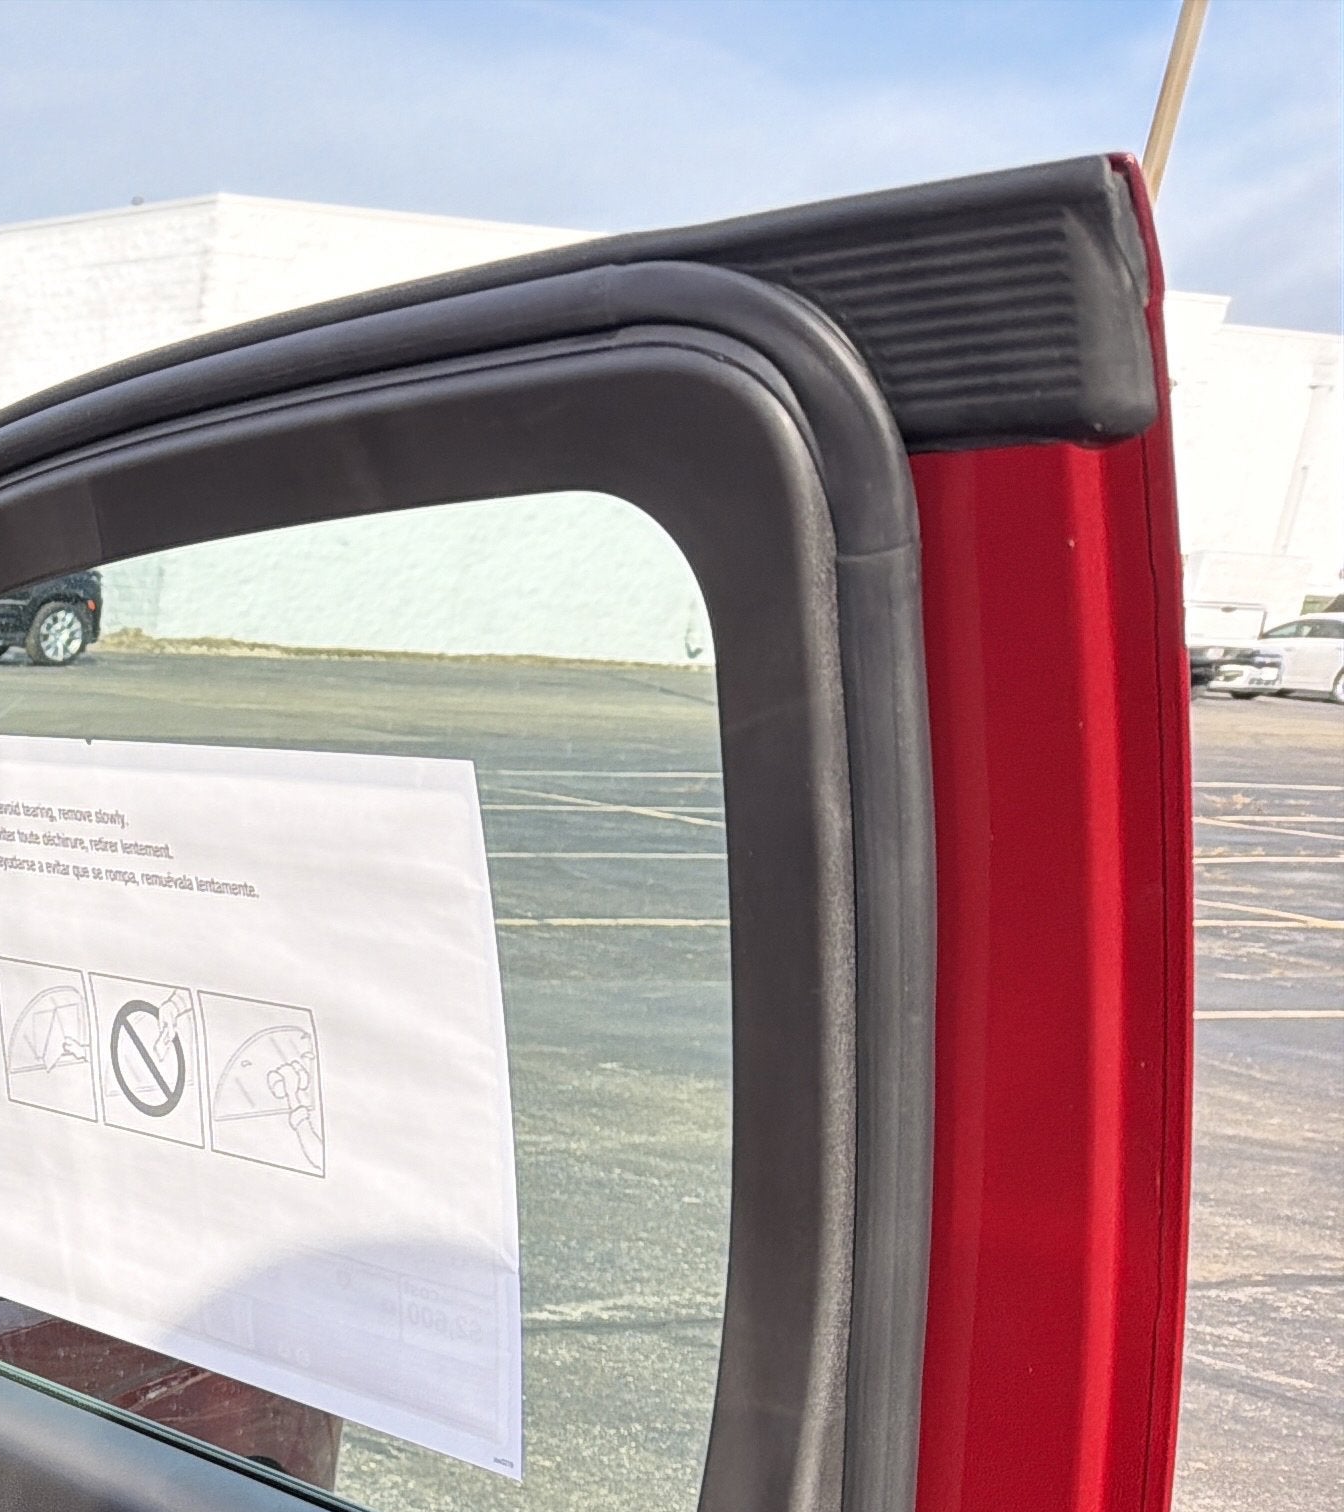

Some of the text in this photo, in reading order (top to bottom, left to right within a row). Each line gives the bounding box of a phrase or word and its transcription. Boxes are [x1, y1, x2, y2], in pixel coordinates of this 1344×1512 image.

[22, 802, 57, 822] tearing,
[58, 807, 92, 823] remove
[94, 809, 130, 829] slowly.
[17, 829, 41, 845] toute
[42, 831, 89, 852] déchirure,
[89, 837, 118, 853] retirer
[120, 839, 174, 859] lentement.
[45, 860, 70, 876] evitar
[72, 865, 90, 880] que
[91, 867, 103, 880] se
[105, 868, 139, 886] rompa,
[195, 876, 260, 898] lentamente.
